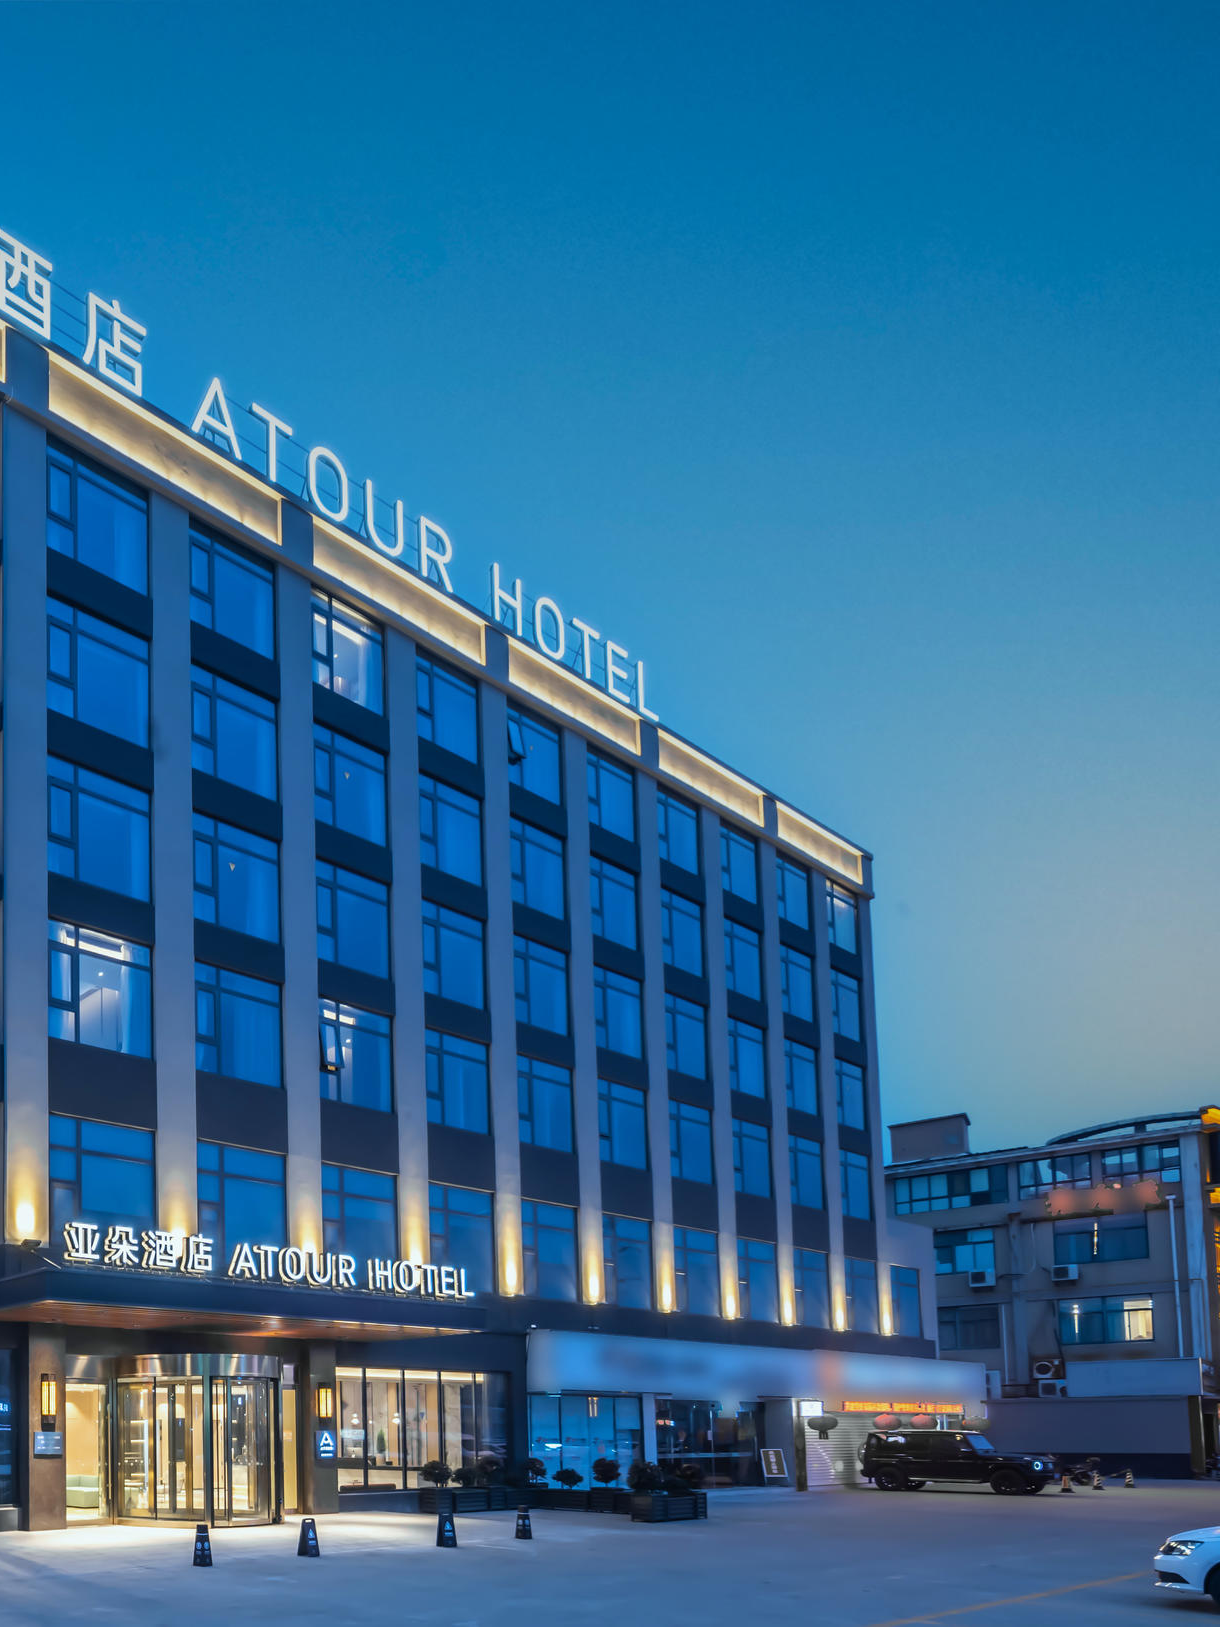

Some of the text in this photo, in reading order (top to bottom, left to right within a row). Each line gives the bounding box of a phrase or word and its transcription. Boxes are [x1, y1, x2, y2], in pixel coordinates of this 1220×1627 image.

[191, 376, 659, 722] ATOUR HOTEL
[65, 1221, 214, 1272] 亚朵酒店
[231, 1242, 476, 1298] ATOUR HOTEL
